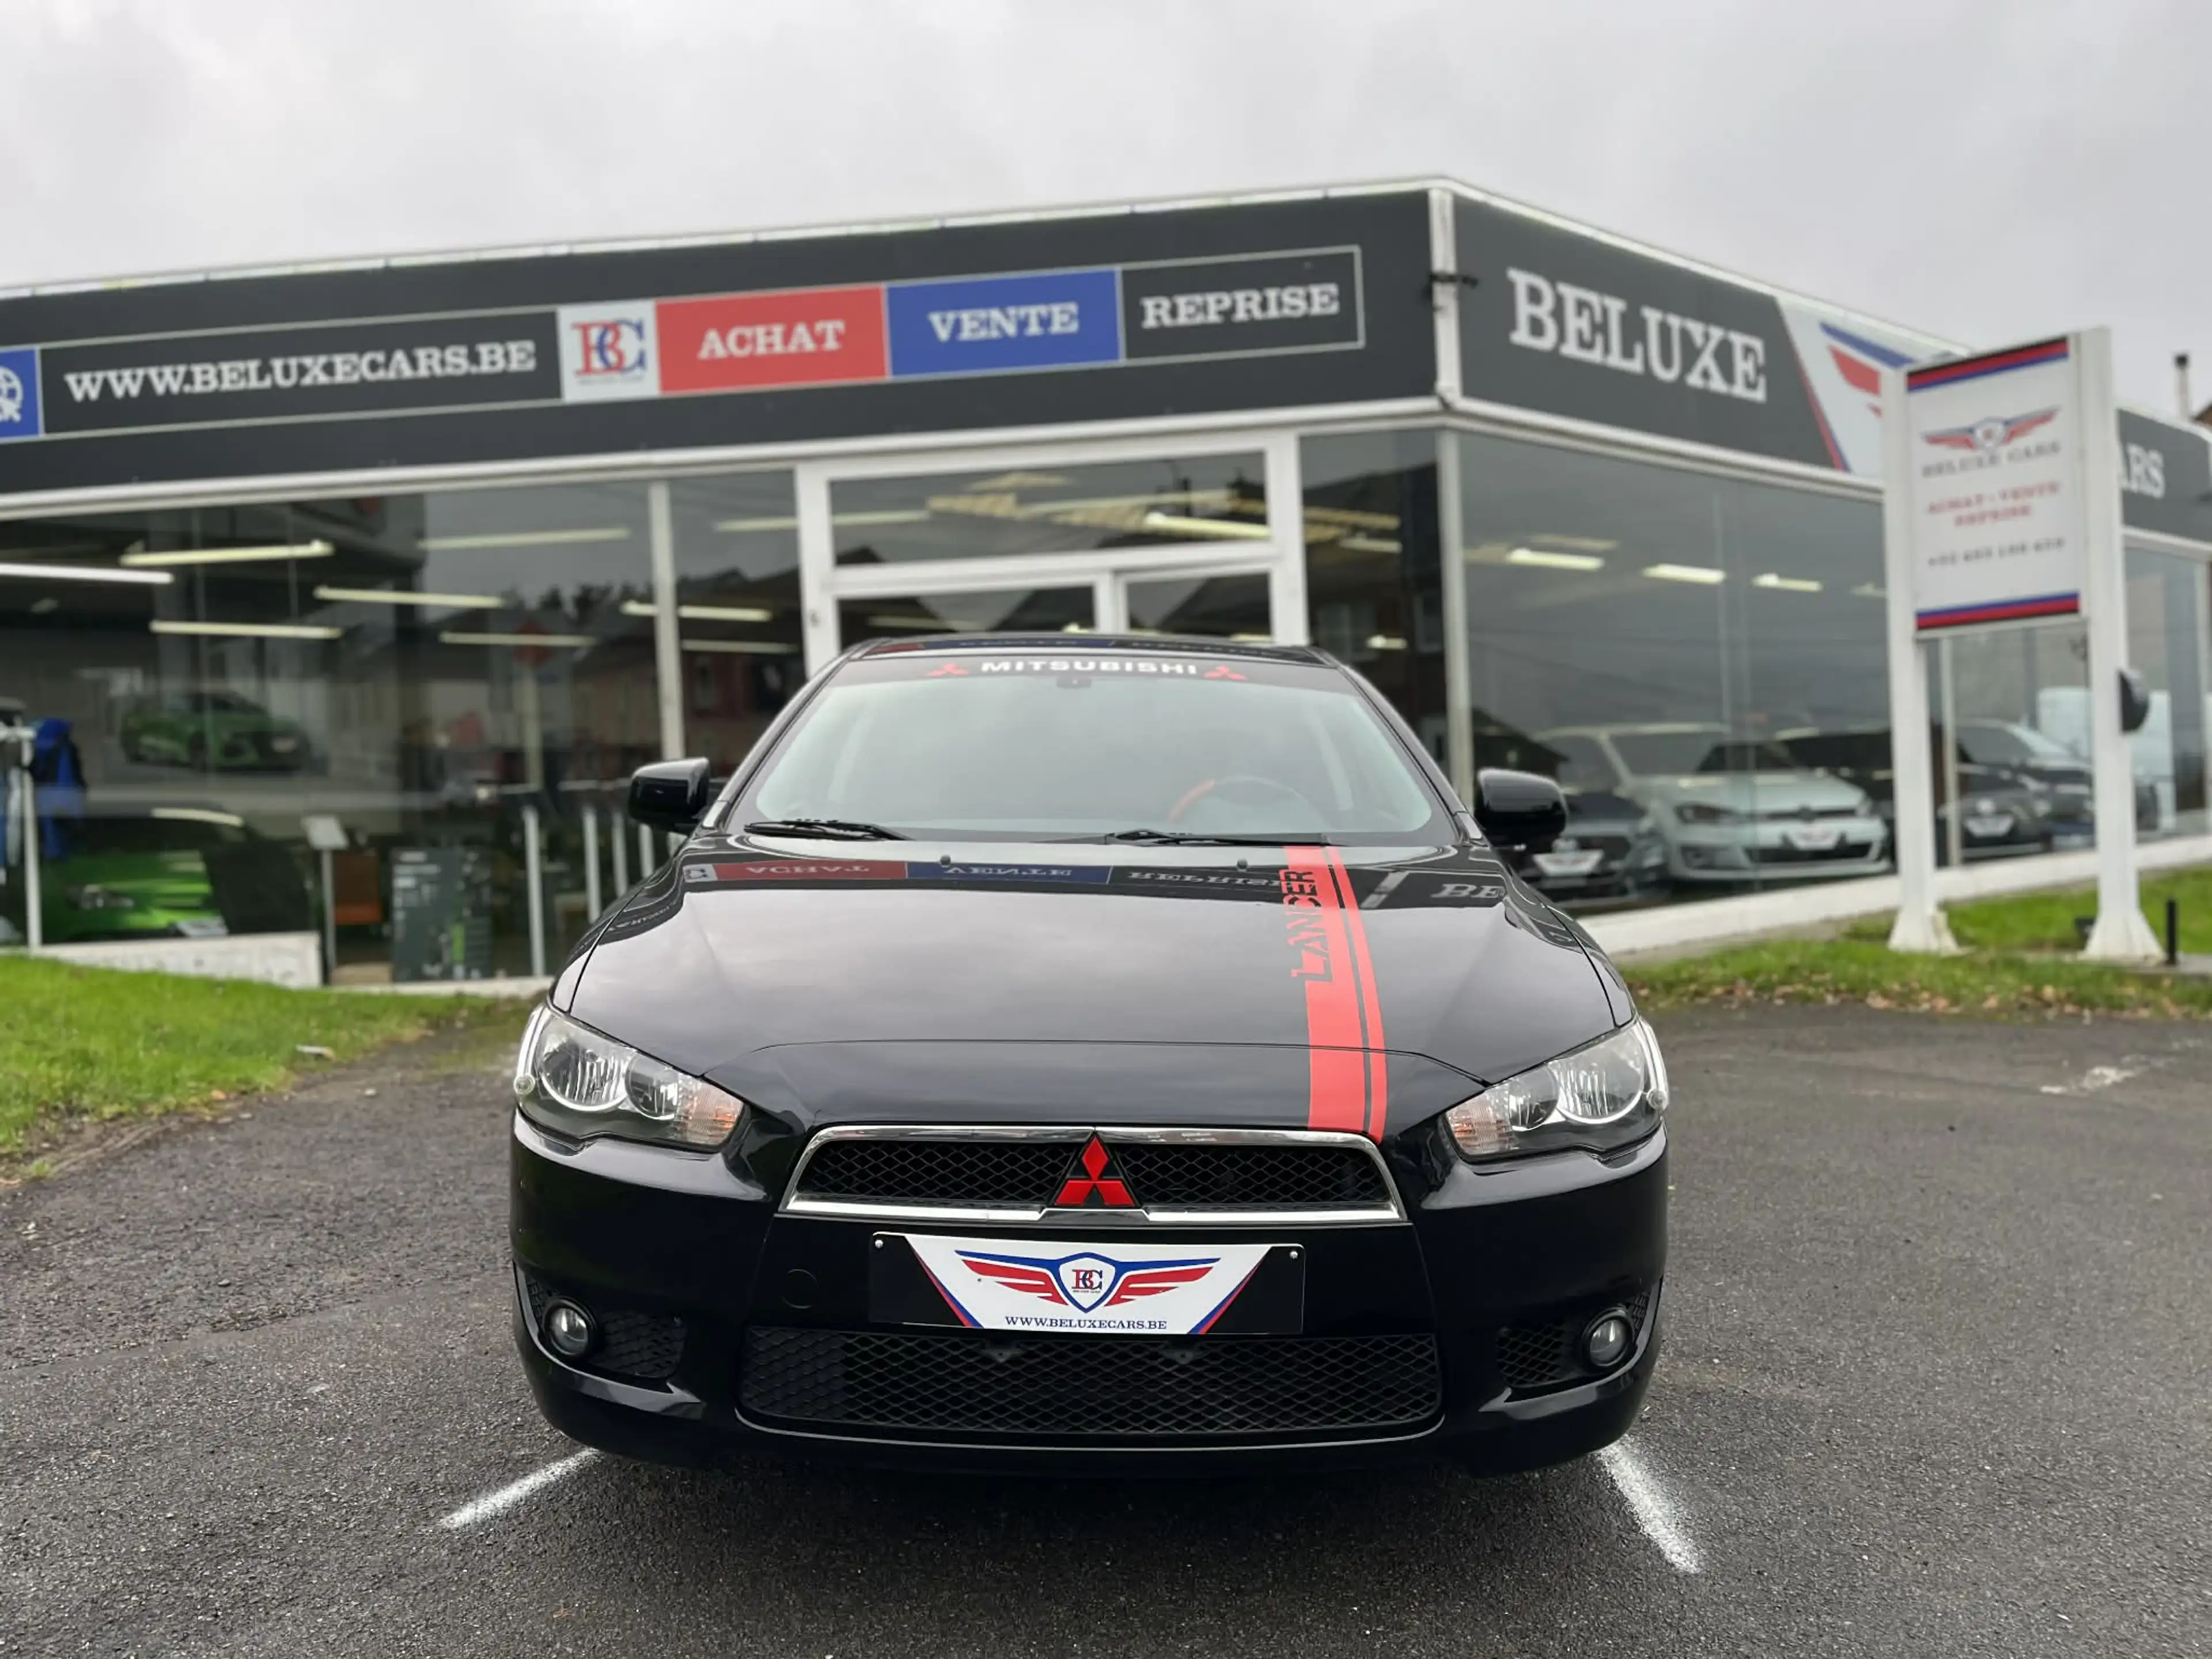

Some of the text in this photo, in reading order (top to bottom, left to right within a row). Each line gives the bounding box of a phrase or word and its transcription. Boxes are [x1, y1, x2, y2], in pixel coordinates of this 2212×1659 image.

[927, 302, 1080, 342] VENTE
[1141, 282, 1341, 329] REPRISE
[697, 319, 846, 361] ACHAT
[1506, 266, 1767, 403] BELUXE
[65, 340, 537, 402] WWW.BELUXECARS.BE
[981, 661, 1197, 675] MITSUBISHI
[1280, 869, 1334, 983] LANCER
[1005, 1316, 1168, 1330] WWW.BELUXECARS.BE
